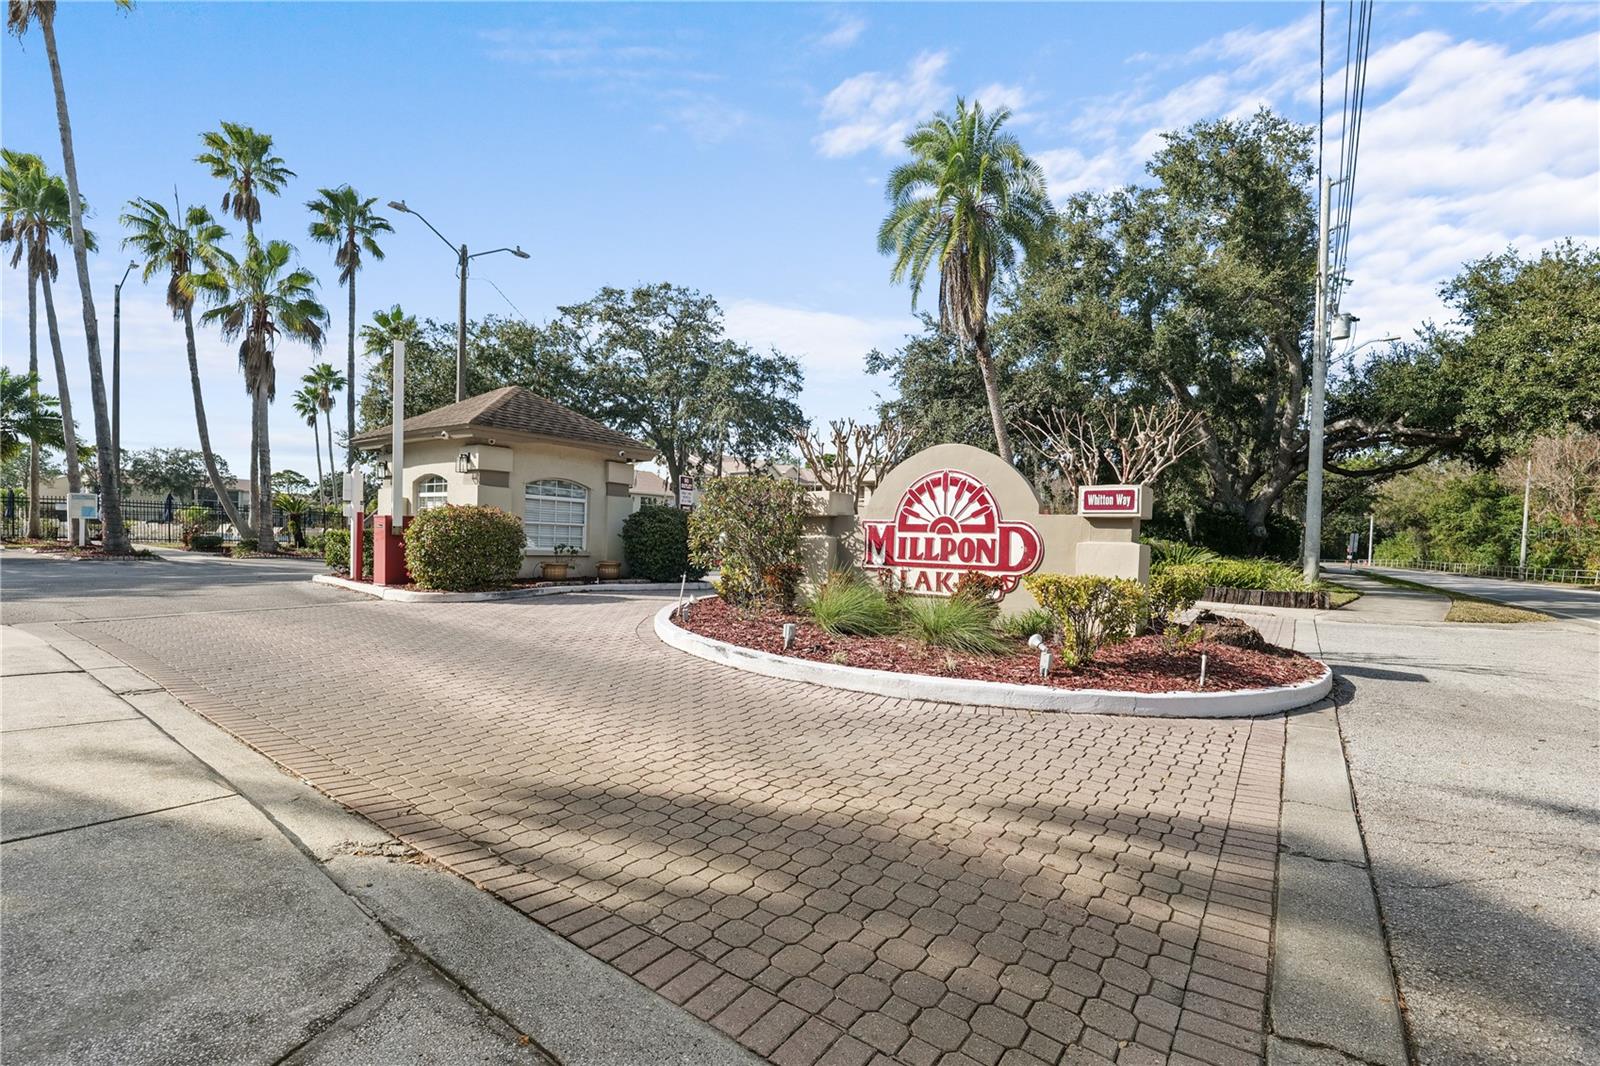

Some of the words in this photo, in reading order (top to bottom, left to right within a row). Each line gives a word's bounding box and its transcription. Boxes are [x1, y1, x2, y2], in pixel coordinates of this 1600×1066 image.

[1087, 494, 1114, 506] Whitton
[1115, 493, 1131, 507] Way
[866, 524, 1038, 571] MILLPOND
